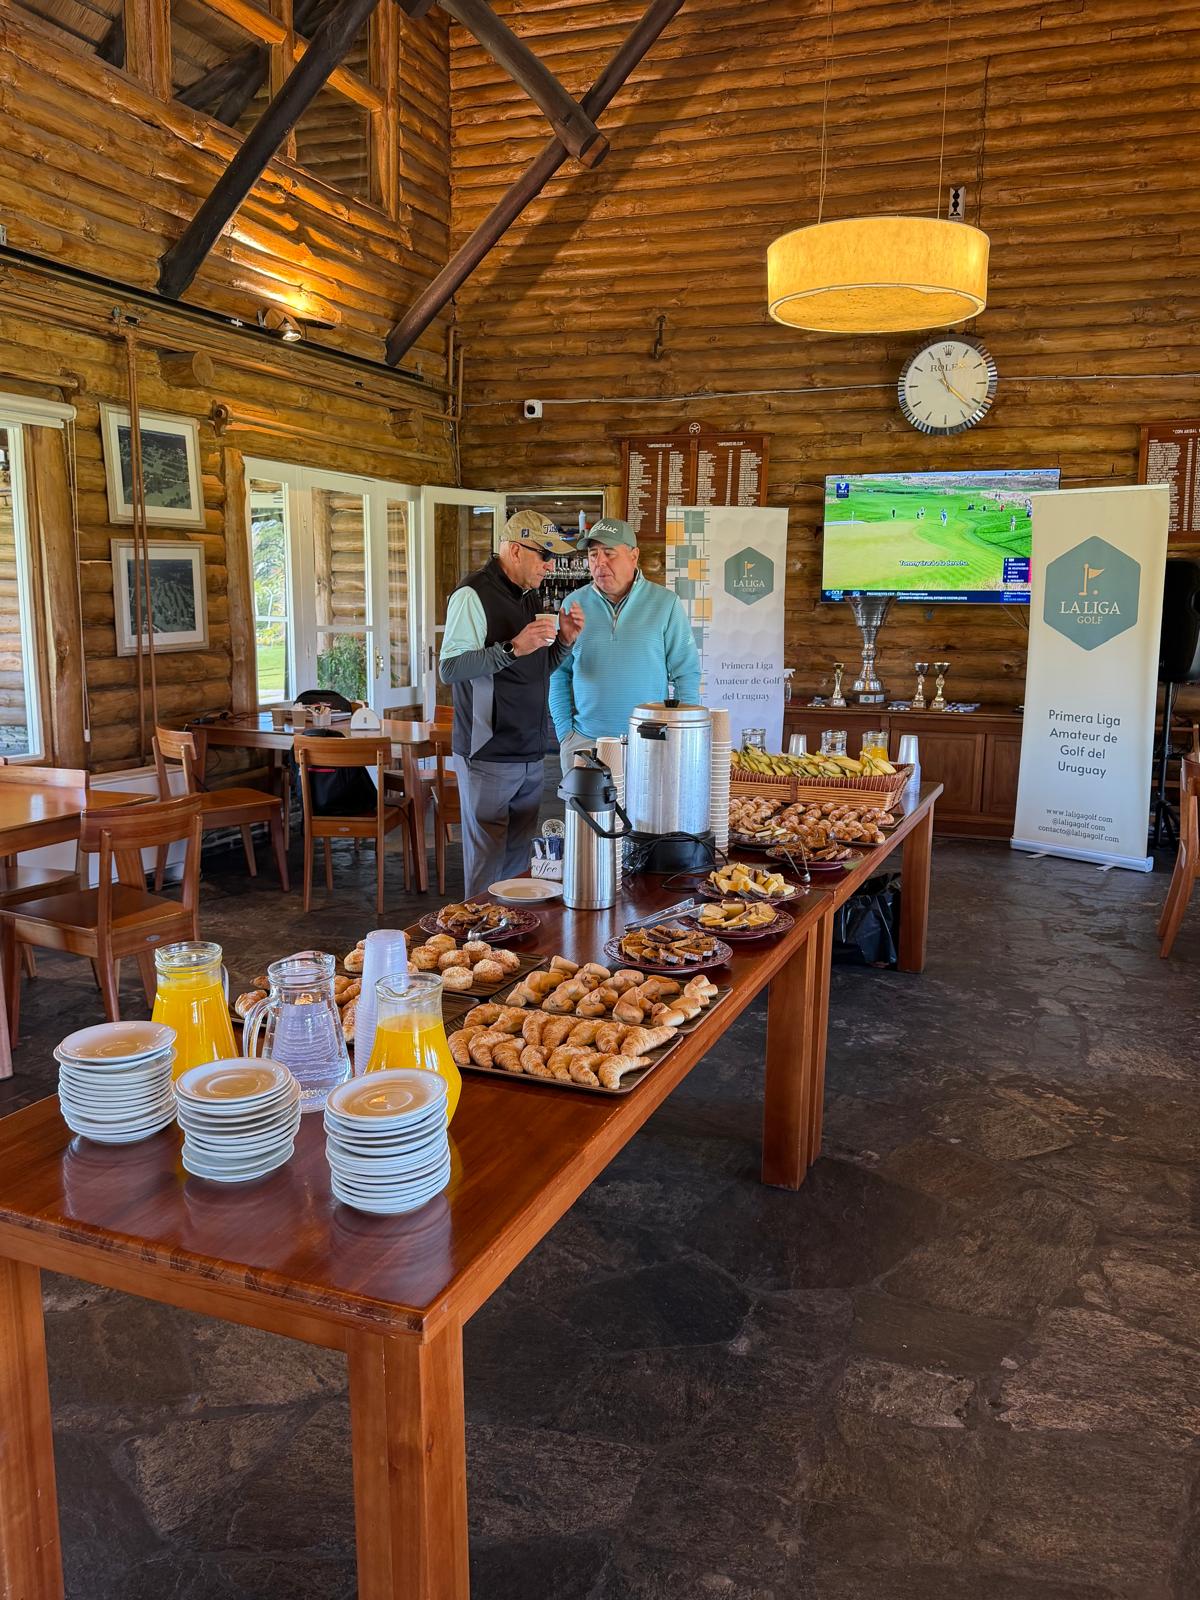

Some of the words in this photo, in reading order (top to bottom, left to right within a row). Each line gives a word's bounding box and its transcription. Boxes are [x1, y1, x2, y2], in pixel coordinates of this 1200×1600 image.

[840, 482, 846, 490] 9
[1076, 615, 1103, 625] GOLF
[721, 662, 754, 670] Primera
[756, 662, 774, 671] Liga
[762, 677, 782, 685] Golf
[722, 693, 735, 701] del
[736, 693, 770, 701] Uruguay
[1048, 709, 1093, 724] Primera
[1096, 712, 1121, 729] Liga
[1049, 727, 1101, 742] Amateur
[1103, 732, 1118, 743] de
[1060, 744, 1086, 757] Golf
[1087, 748, 1106, 759] del
[1058, 761, 1107, 779] Uruguay
[1046, 808, 1113, 824] www.laligagolf.com
[1051, 818, 1106, 832] @laligagolf.com
[1038, 824, 1120, 844] contacto@laligagolf.com
